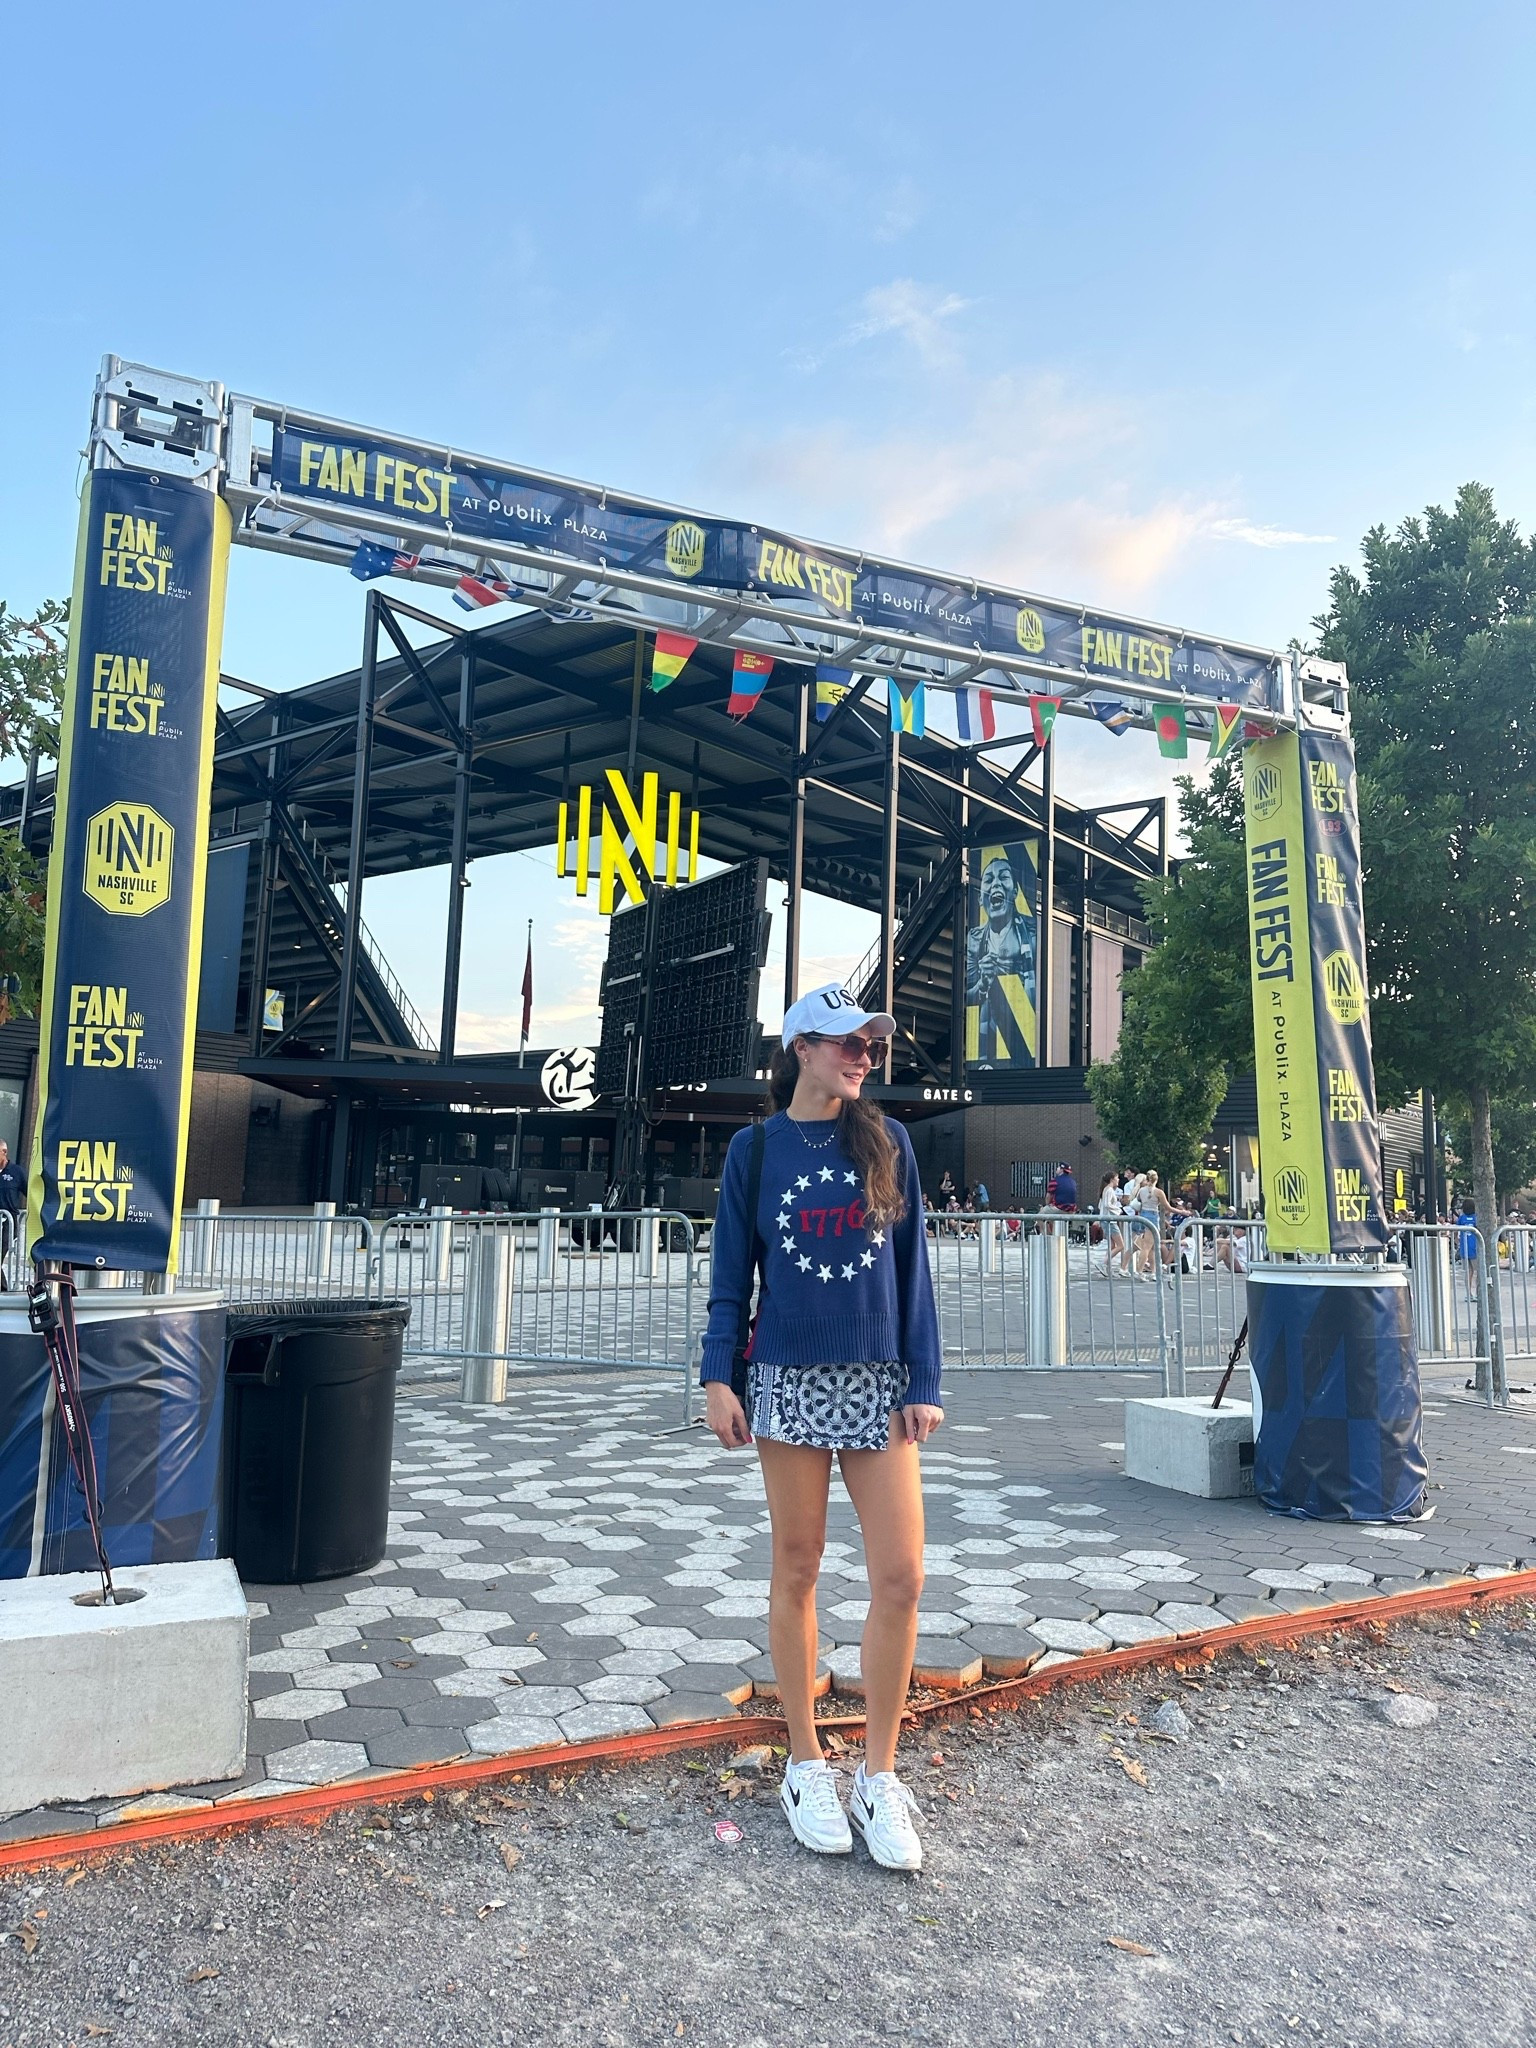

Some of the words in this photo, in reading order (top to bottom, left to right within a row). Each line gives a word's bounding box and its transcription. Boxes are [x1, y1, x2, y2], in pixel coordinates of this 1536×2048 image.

[300, 441, 367, 498] FAN
[375, 454, 457, 518] FEST
[462, 497, 481, 510] AT
[488, 499, 553, 526] Publix
[564, 518, 608, 542] PLAZA
[103, 512, 157, 556] FAN
[100, 549, 173, 595] FEST
[671, 556, 698, 567] NASHVILLE
[758, 540, 805, 589] FAN
[804, 555, 857, 612] FEST
[861, 592, 877, 602] AT
[882, 592, 931, 616] Publix
[938, 609, 973, 626] PLAZA
[1081, 626, 1122, 669] FAN
[1126, 634, 1173, 681] FEST
[1177, 664, 1188, 673] AT
[1193, 663, 1231, 682] Publix
[93, 653, 149, 696] FAN
[90, 691, 165, 736] FEST
[158, 732, 178, 740] PLAZA
[1308, 760, 1338, 788] FAN
[1311, 785, 1346, 814] FEST
[1251, 839, 1288, 903] FAN
[1315, 853, 1338, 882] FAN
[98, 874, 157, 893] NASHVILLE
[119, 891, 134, 905] SC
[1317, 878, 1346, 908] FEST
[1254, 905, 1294, 982] FEST
[69, 985, 127, 1027] FAN
[820, 989, 861, 1010] US
[1271, 991, 1282, 1008] AT
[1340, 1008, 1349, 1018] SC
[66, 1026, 144, 1068] FEST
[137, 1057, 163, 1065] Publix
[1273, 1016, 1288, 1079] Publix
[923, 1088, 958, 1101] GATE
[964, 1089, 973, 1102] C
[1328, 1069, 1356, 1095] FAN
[1279, 1092, 1292, 1142] PLAZA
[1330, 1096, 1363, 1122] FEST
[57, 1140, 116, 1181] FAN
[1333, 1168, 1360, 1195] FAN
[55, 1181, 134, 1222] FEST
[1281, 1205, 1306, 1213] NASHVILLE
[1335, 1195, 1371, 1222] FEST
[799, 1199, 865, 1238] 1776
[64, 1404, 74, 1425] HUSKY
